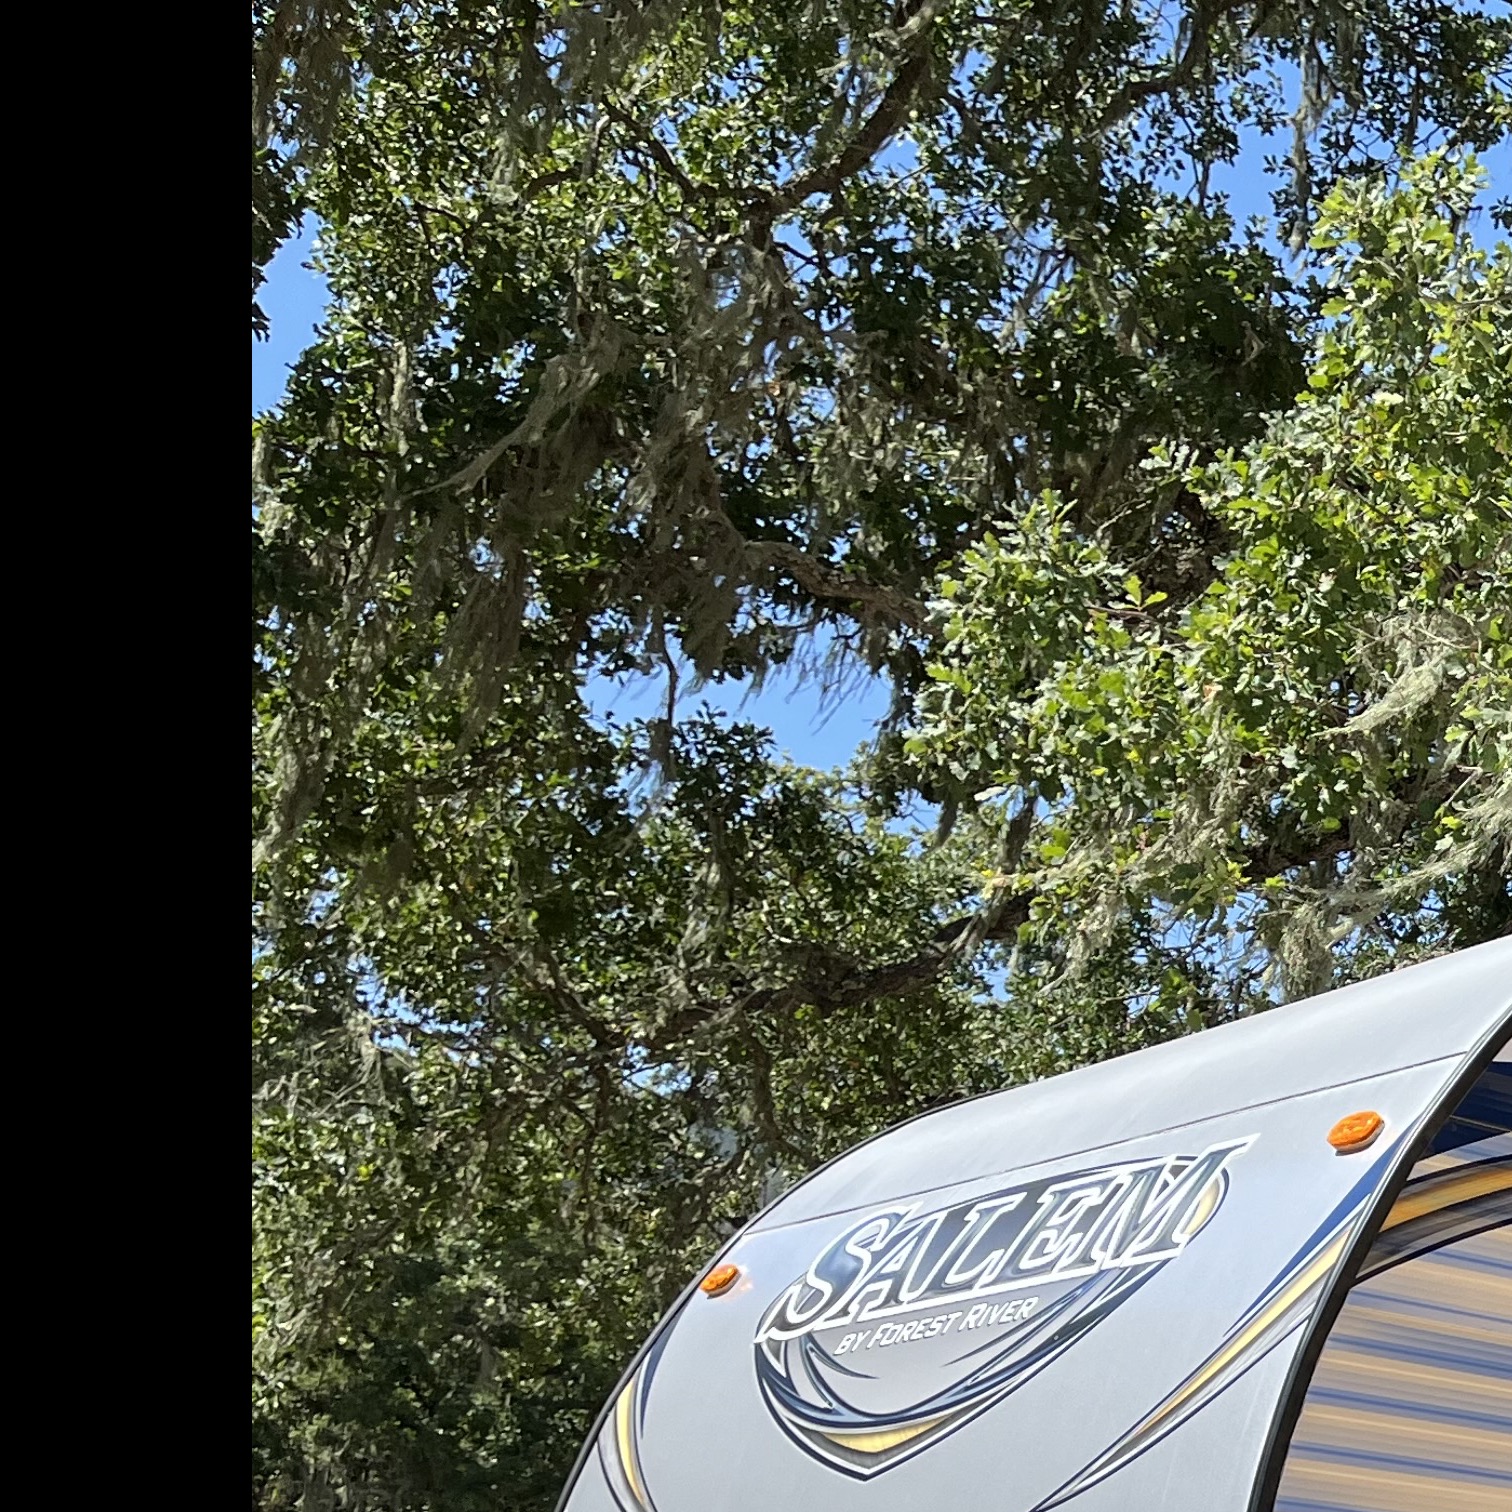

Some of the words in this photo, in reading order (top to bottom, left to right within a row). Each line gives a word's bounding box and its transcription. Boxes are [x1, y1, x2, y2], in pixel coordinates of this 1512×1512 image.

[753, 1133, 1260, 1343] SALEM
[833, 1329, 872, 1356] BY
[866, 1311, 962, 1350] FOREST
[957, 1296, 1039, 1333] RIVER
